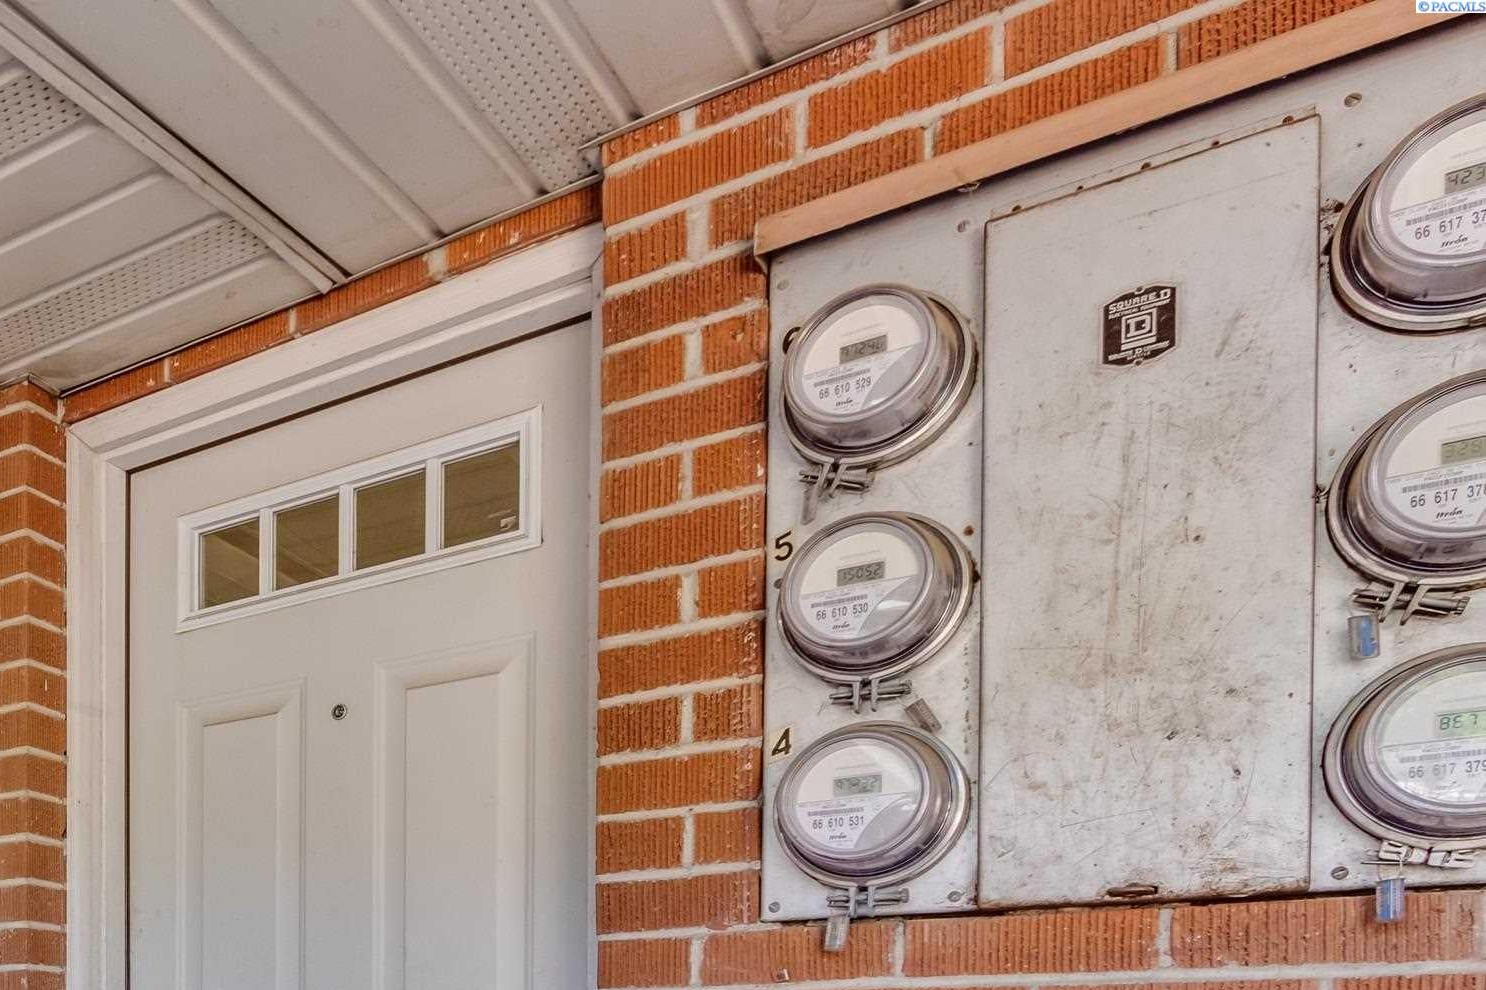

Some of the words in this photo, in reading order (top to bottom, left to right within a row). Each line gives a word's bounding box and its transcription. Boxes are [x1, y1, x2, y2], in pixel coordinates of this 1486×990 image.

[1414, 225, 1431, 240] 66
[1439, 216, 1463, 233] 617
[1108, 291, 1157, 314] SQUARE
[1159, 288, 1171, 300] D
[834, 382, 851, 396] 610
[1409, 494, 1426, 508] 66
[1434, 488, 1458, 504] 617
[774, 530, 794, 561] 5
[831, 606, 848, 619] 610
[852, 602, 869, 615] 530
[771, 727, 792, 756] 4
[1408, 765, 1425, 779] 66
[1433, 763, 1457, 777] 617
[828, 816, 844, 828] 610
[849, 815, 864, 827] 531
